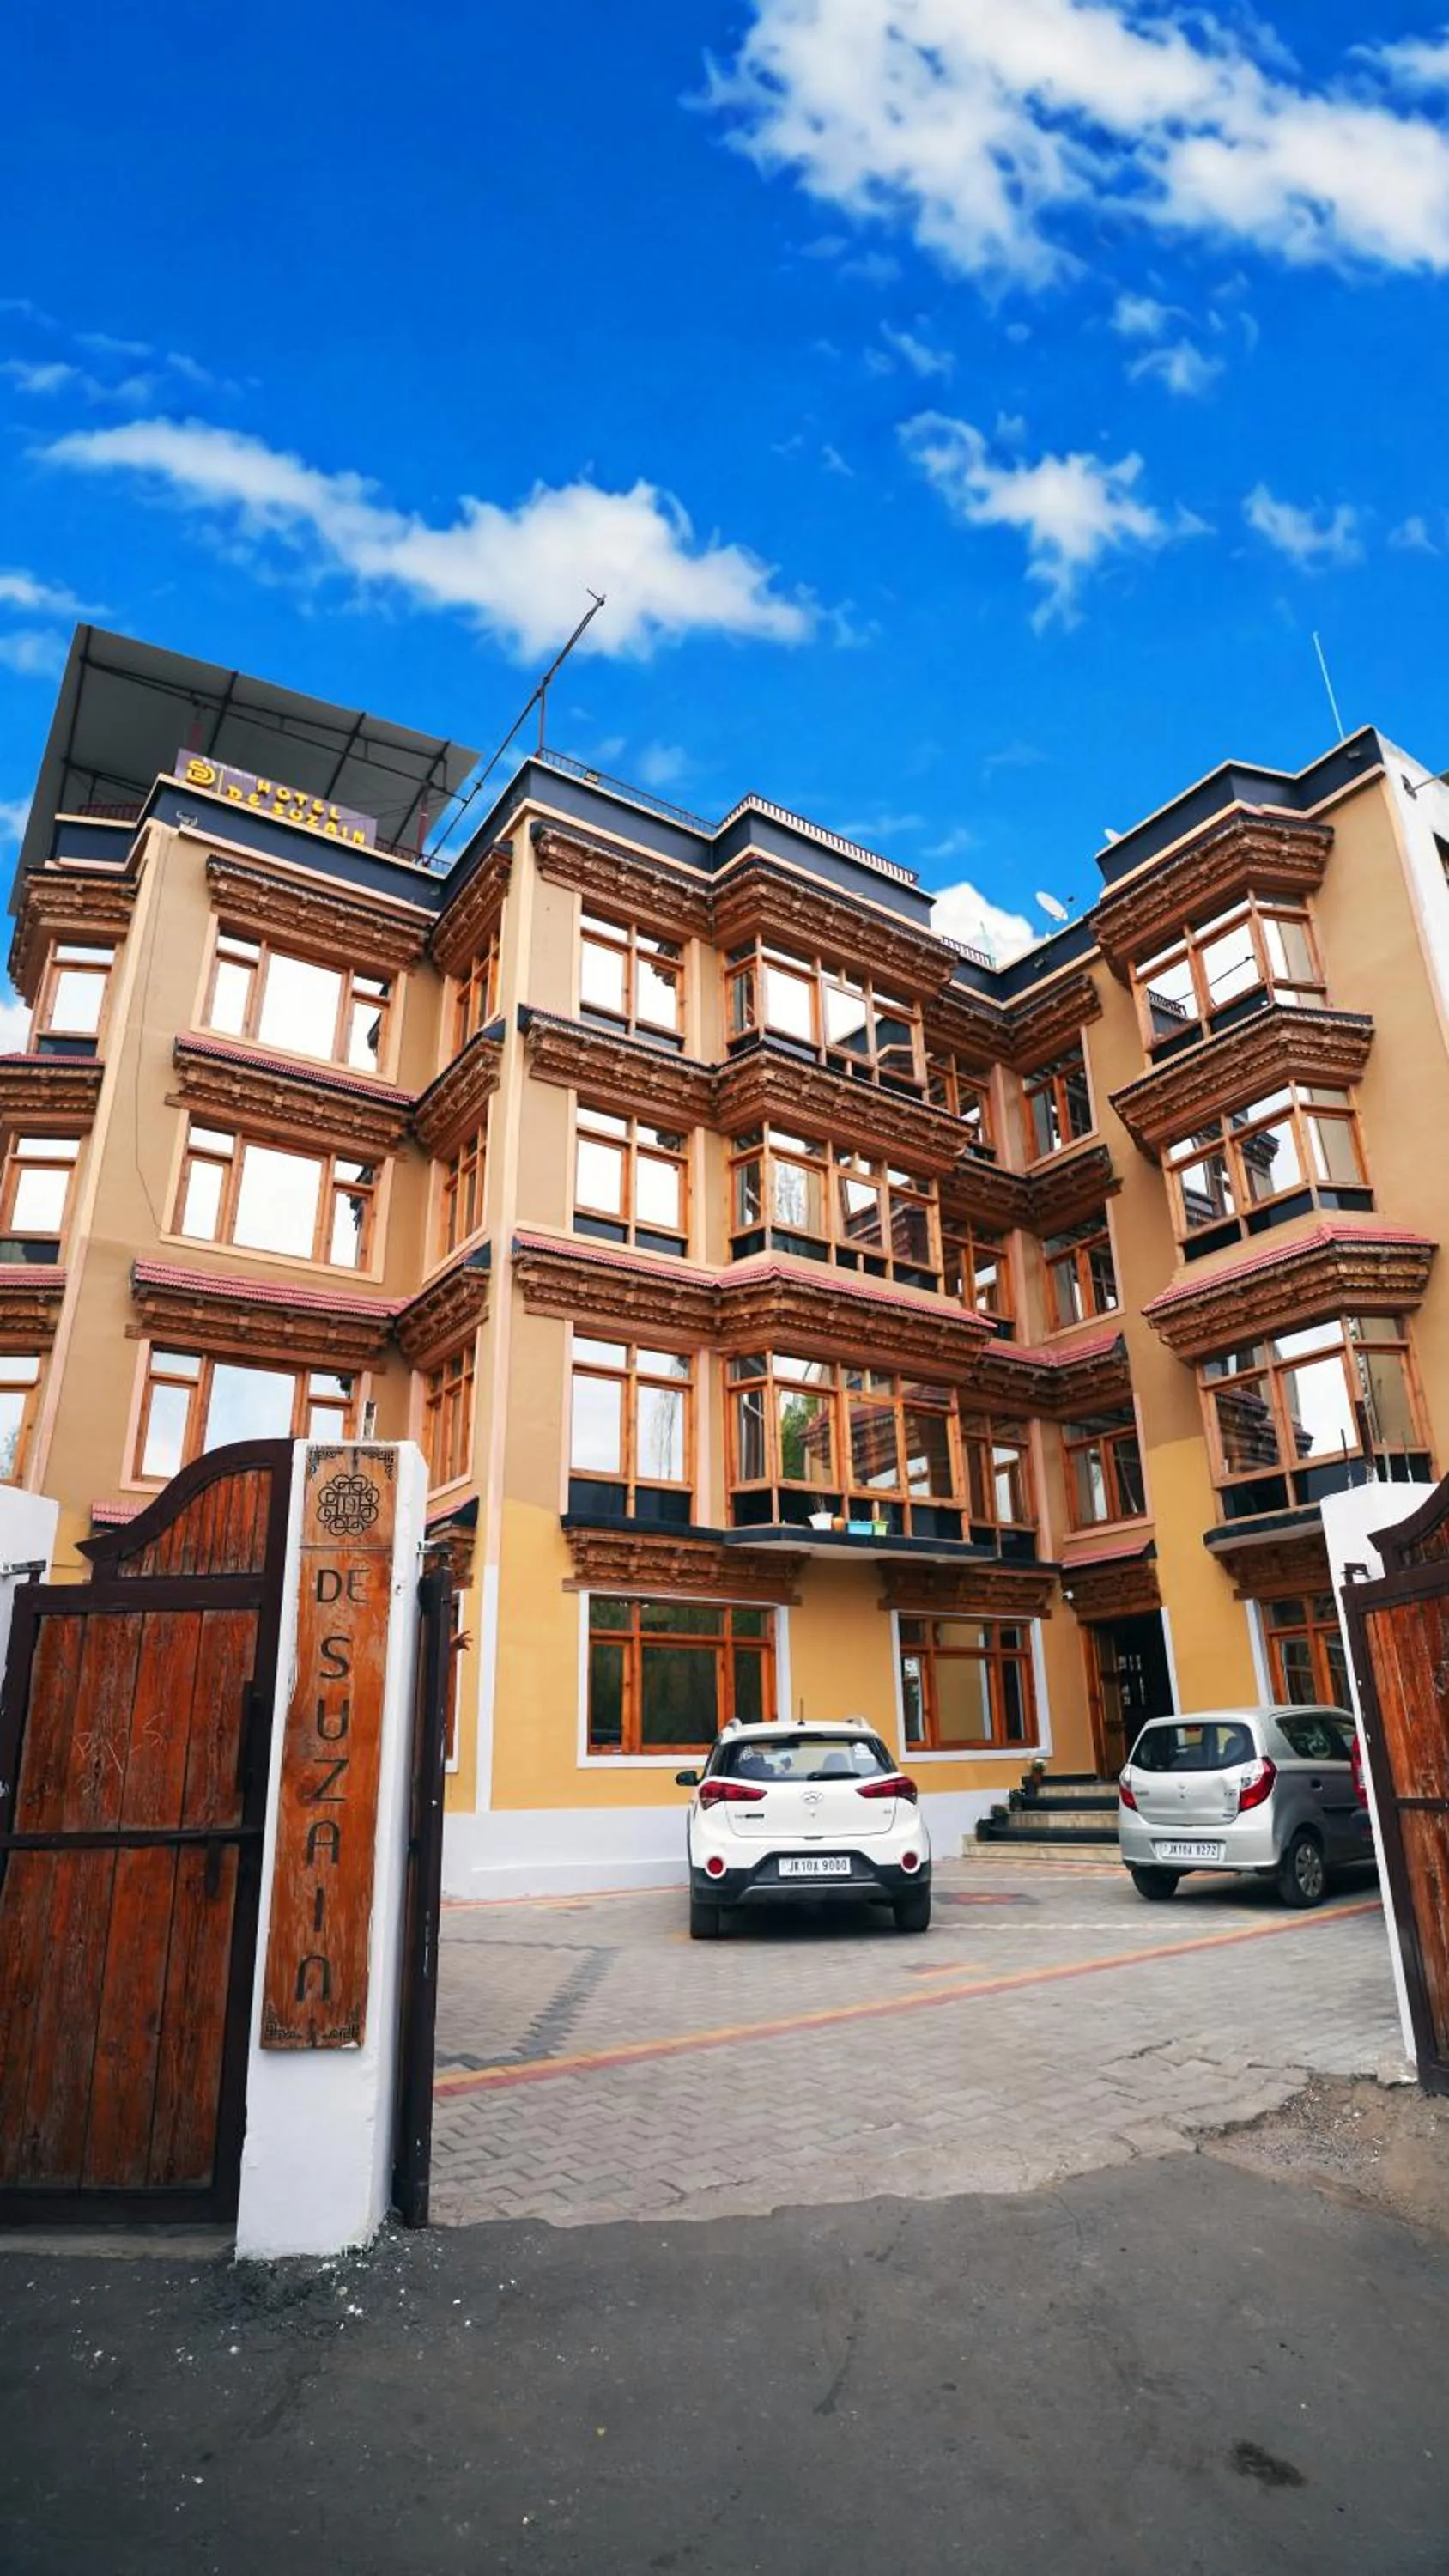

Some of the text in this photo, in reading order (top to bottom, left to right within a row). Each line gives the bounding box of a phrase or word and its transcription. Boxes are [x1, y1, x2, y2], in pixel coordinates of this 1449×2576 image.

[227, 784, 260, 807] DE
[258, 778, 341, 820] HOTEL
[316, 1569, 370, 1603] DE
